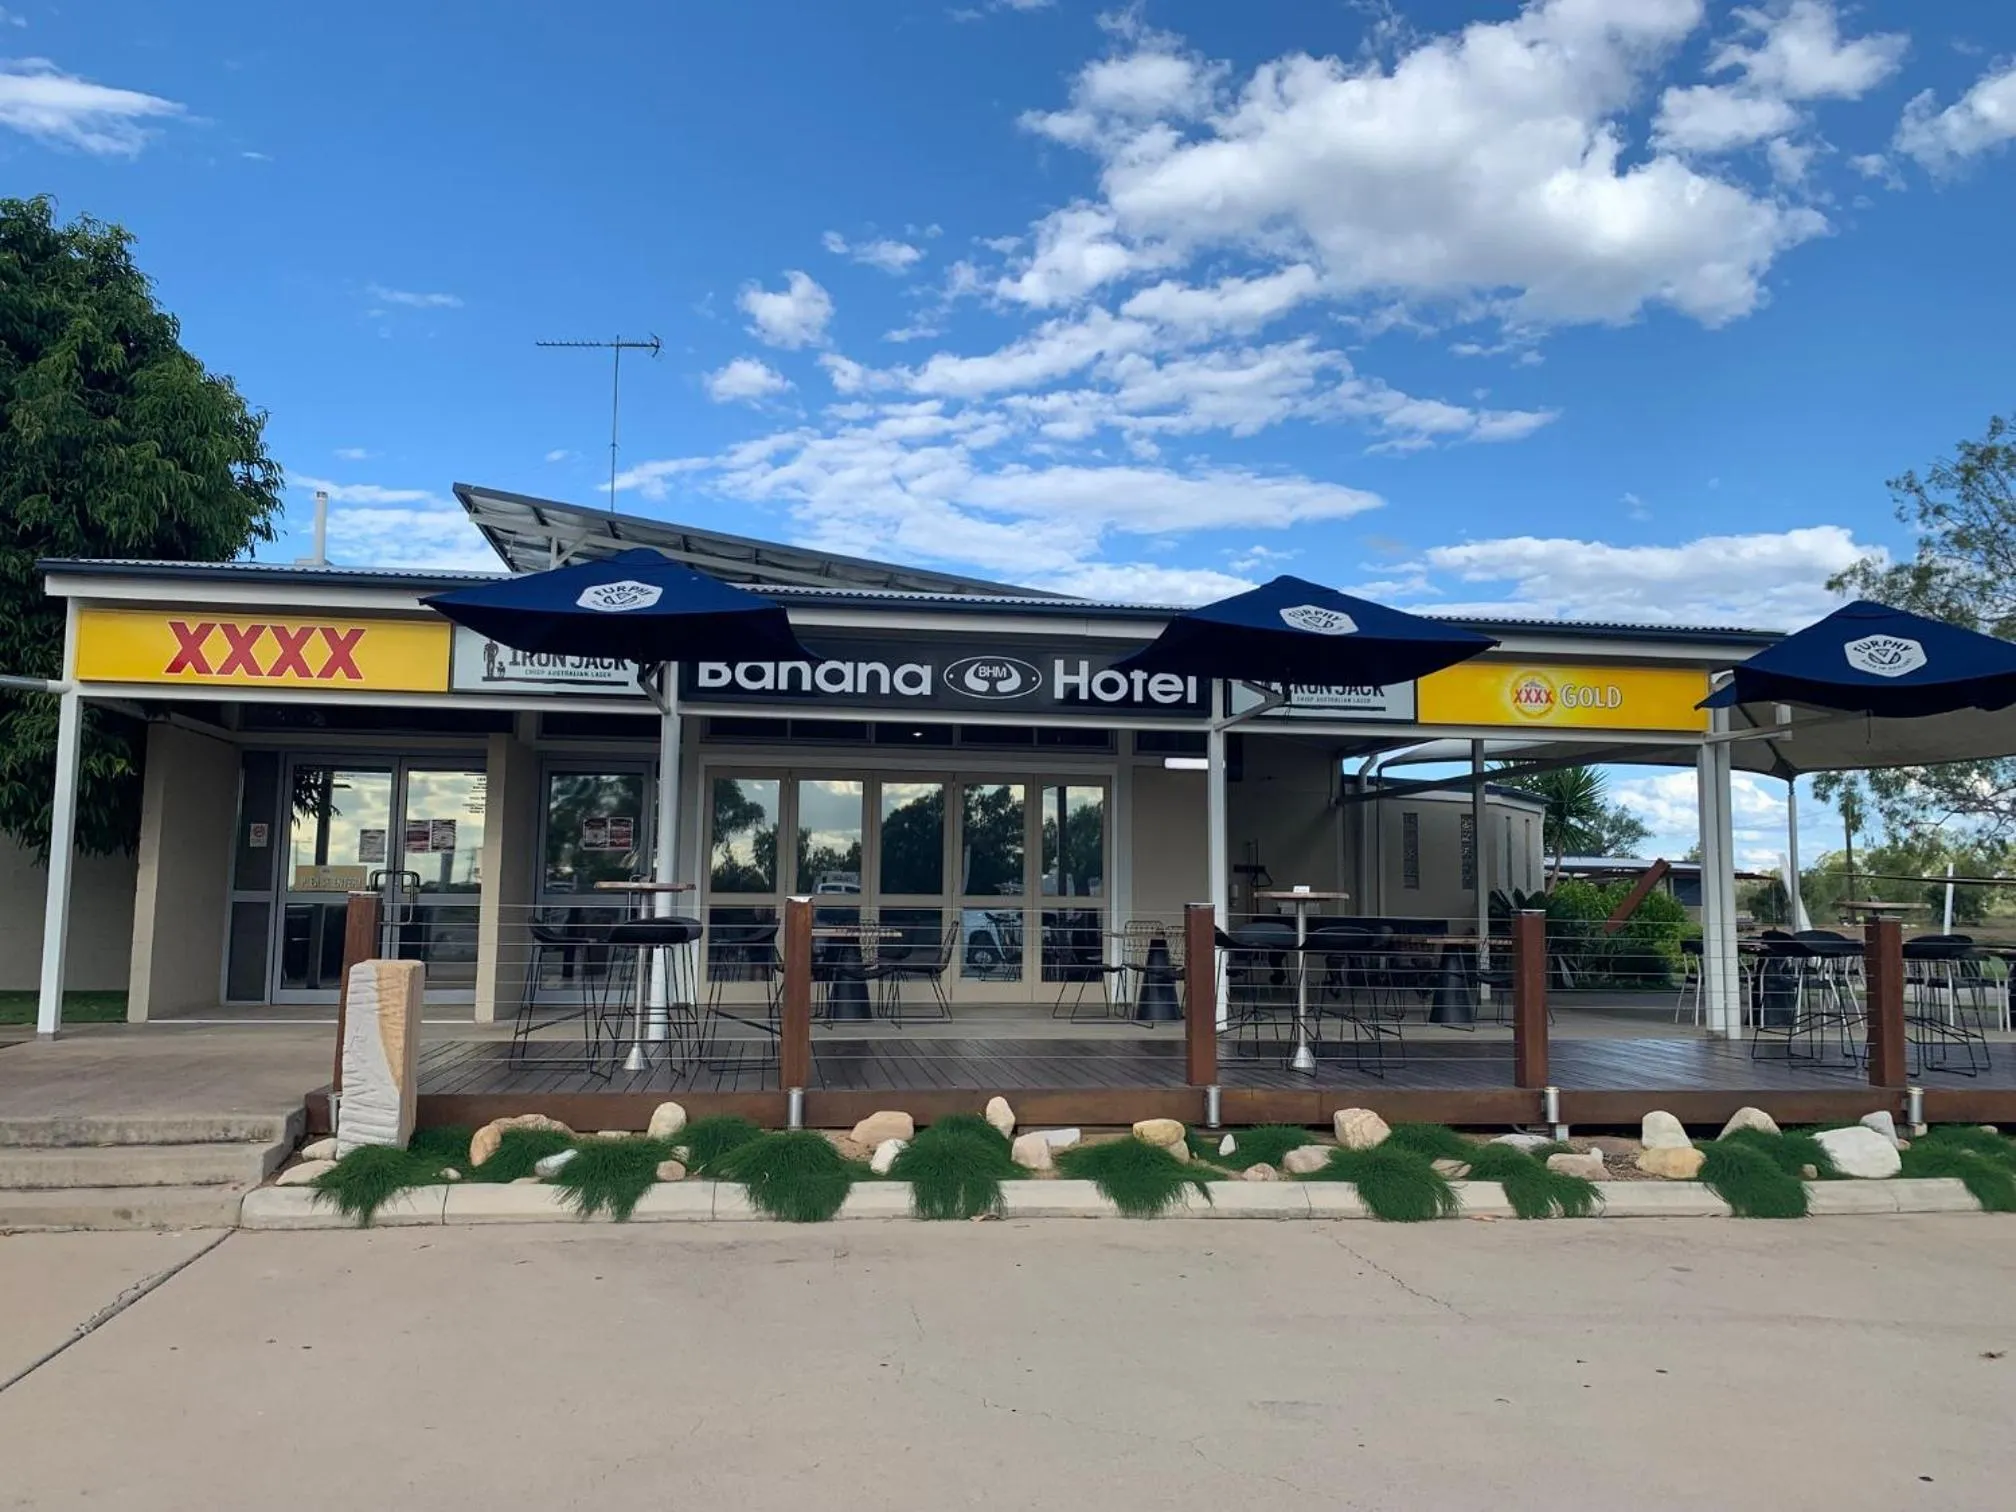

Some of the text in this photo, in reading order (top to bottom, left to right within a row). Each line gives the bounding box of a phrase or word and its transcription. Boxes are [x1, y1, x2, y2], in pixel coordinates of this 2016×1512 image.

[163, 620, 367, 681] XXXX
[1853, 639, 1913, 654] FURPHY
[698, 659, 1197, 704] Banana BHM Hotel
[1513, 688, 1554, 704] XXXX
[1561, 684, 1623, 708] GOLD
